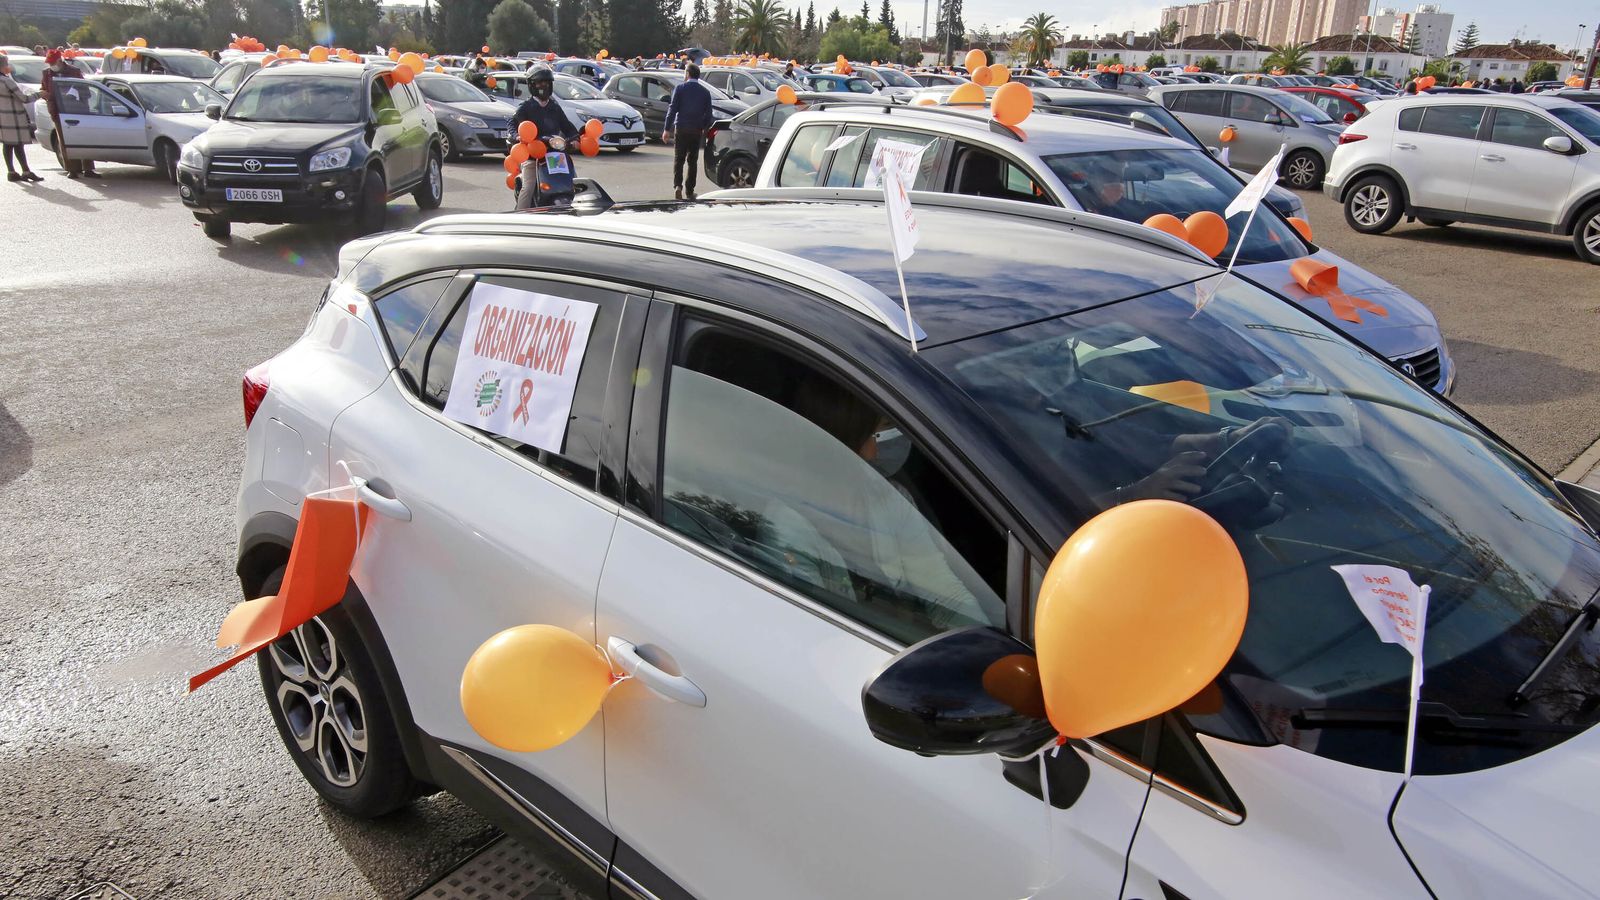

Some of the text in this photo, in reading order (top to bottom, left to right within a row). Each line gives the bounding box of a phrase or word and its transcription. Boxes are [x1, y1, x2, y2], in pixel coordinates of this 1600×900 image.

[234, 190, 280, 200] 2066 GSH
[473, 304, 577, 376] ORGANIZACIÓN
